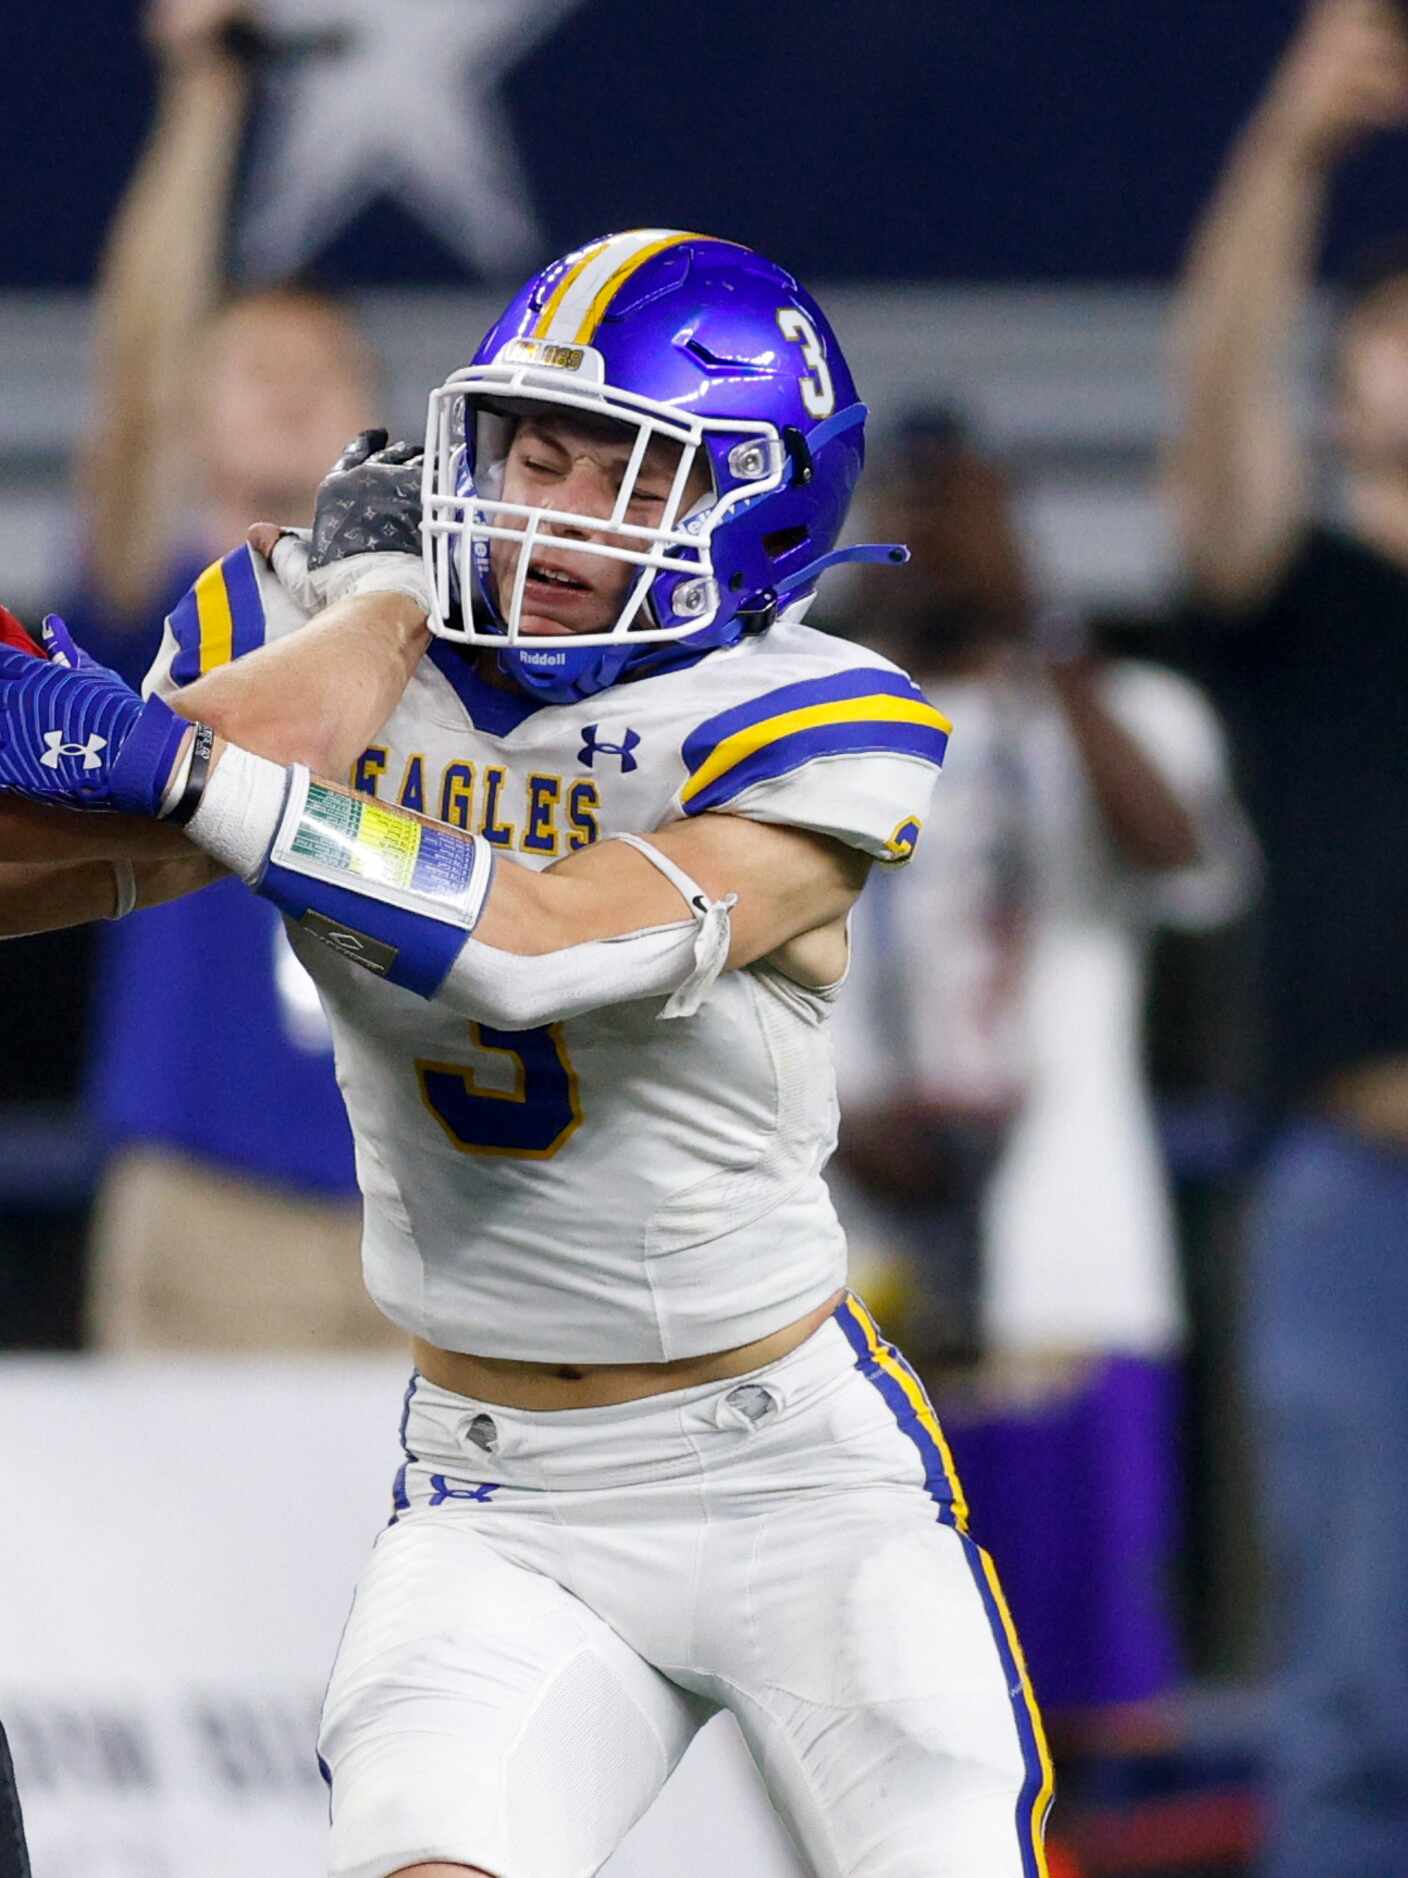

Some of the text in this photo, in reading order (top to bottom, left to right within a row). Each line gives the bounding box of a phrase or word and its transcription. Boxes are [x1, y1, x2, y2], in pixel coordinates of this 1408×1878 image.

[776, 308, 835, 420] 3
[519, 650, 566, 666] Riddell
[352, 744, 601, 856] EAGLES
